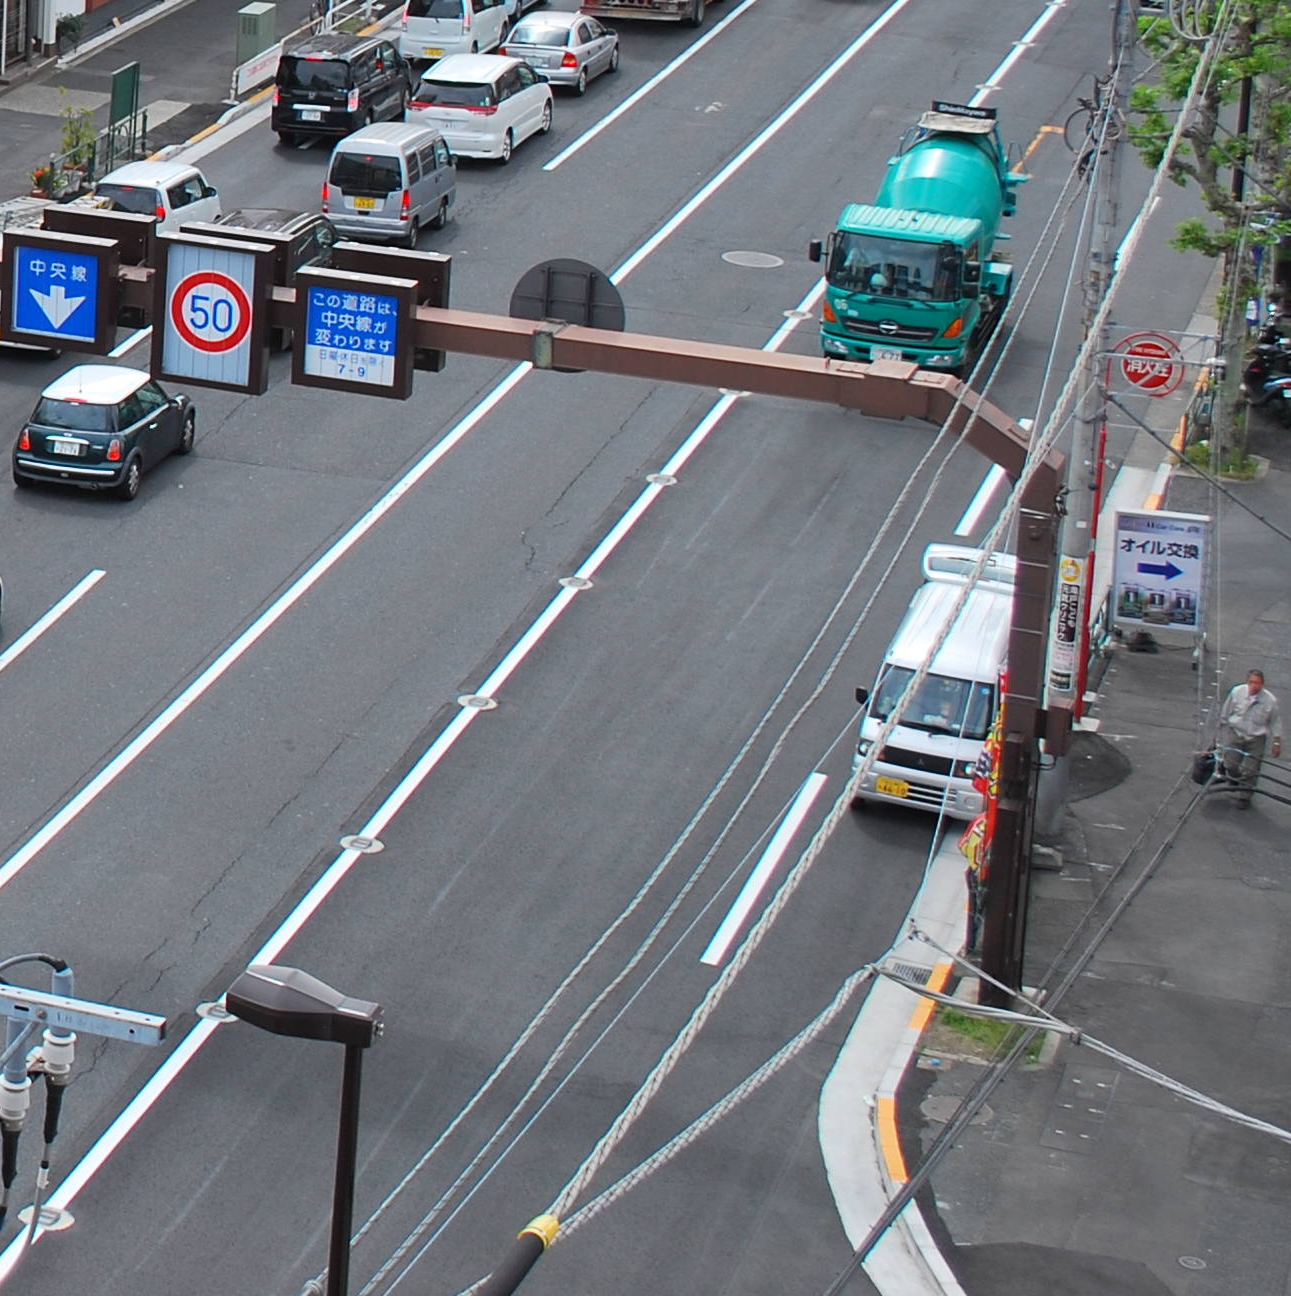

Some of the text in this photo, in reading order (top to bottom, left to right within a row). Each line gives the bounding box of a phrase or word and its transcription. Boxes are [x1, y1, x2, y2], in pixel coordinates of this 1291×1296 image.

[29, 258, 88, 283] 中央線
[189, 294, 234, 333] 50
[312, 292, 398, 317] この道路は、
[320, 310, 387, 335] 中央線が
[314, 328, 393, 353] 変わります
[1119, 537, 1200, 560] オイル交換
